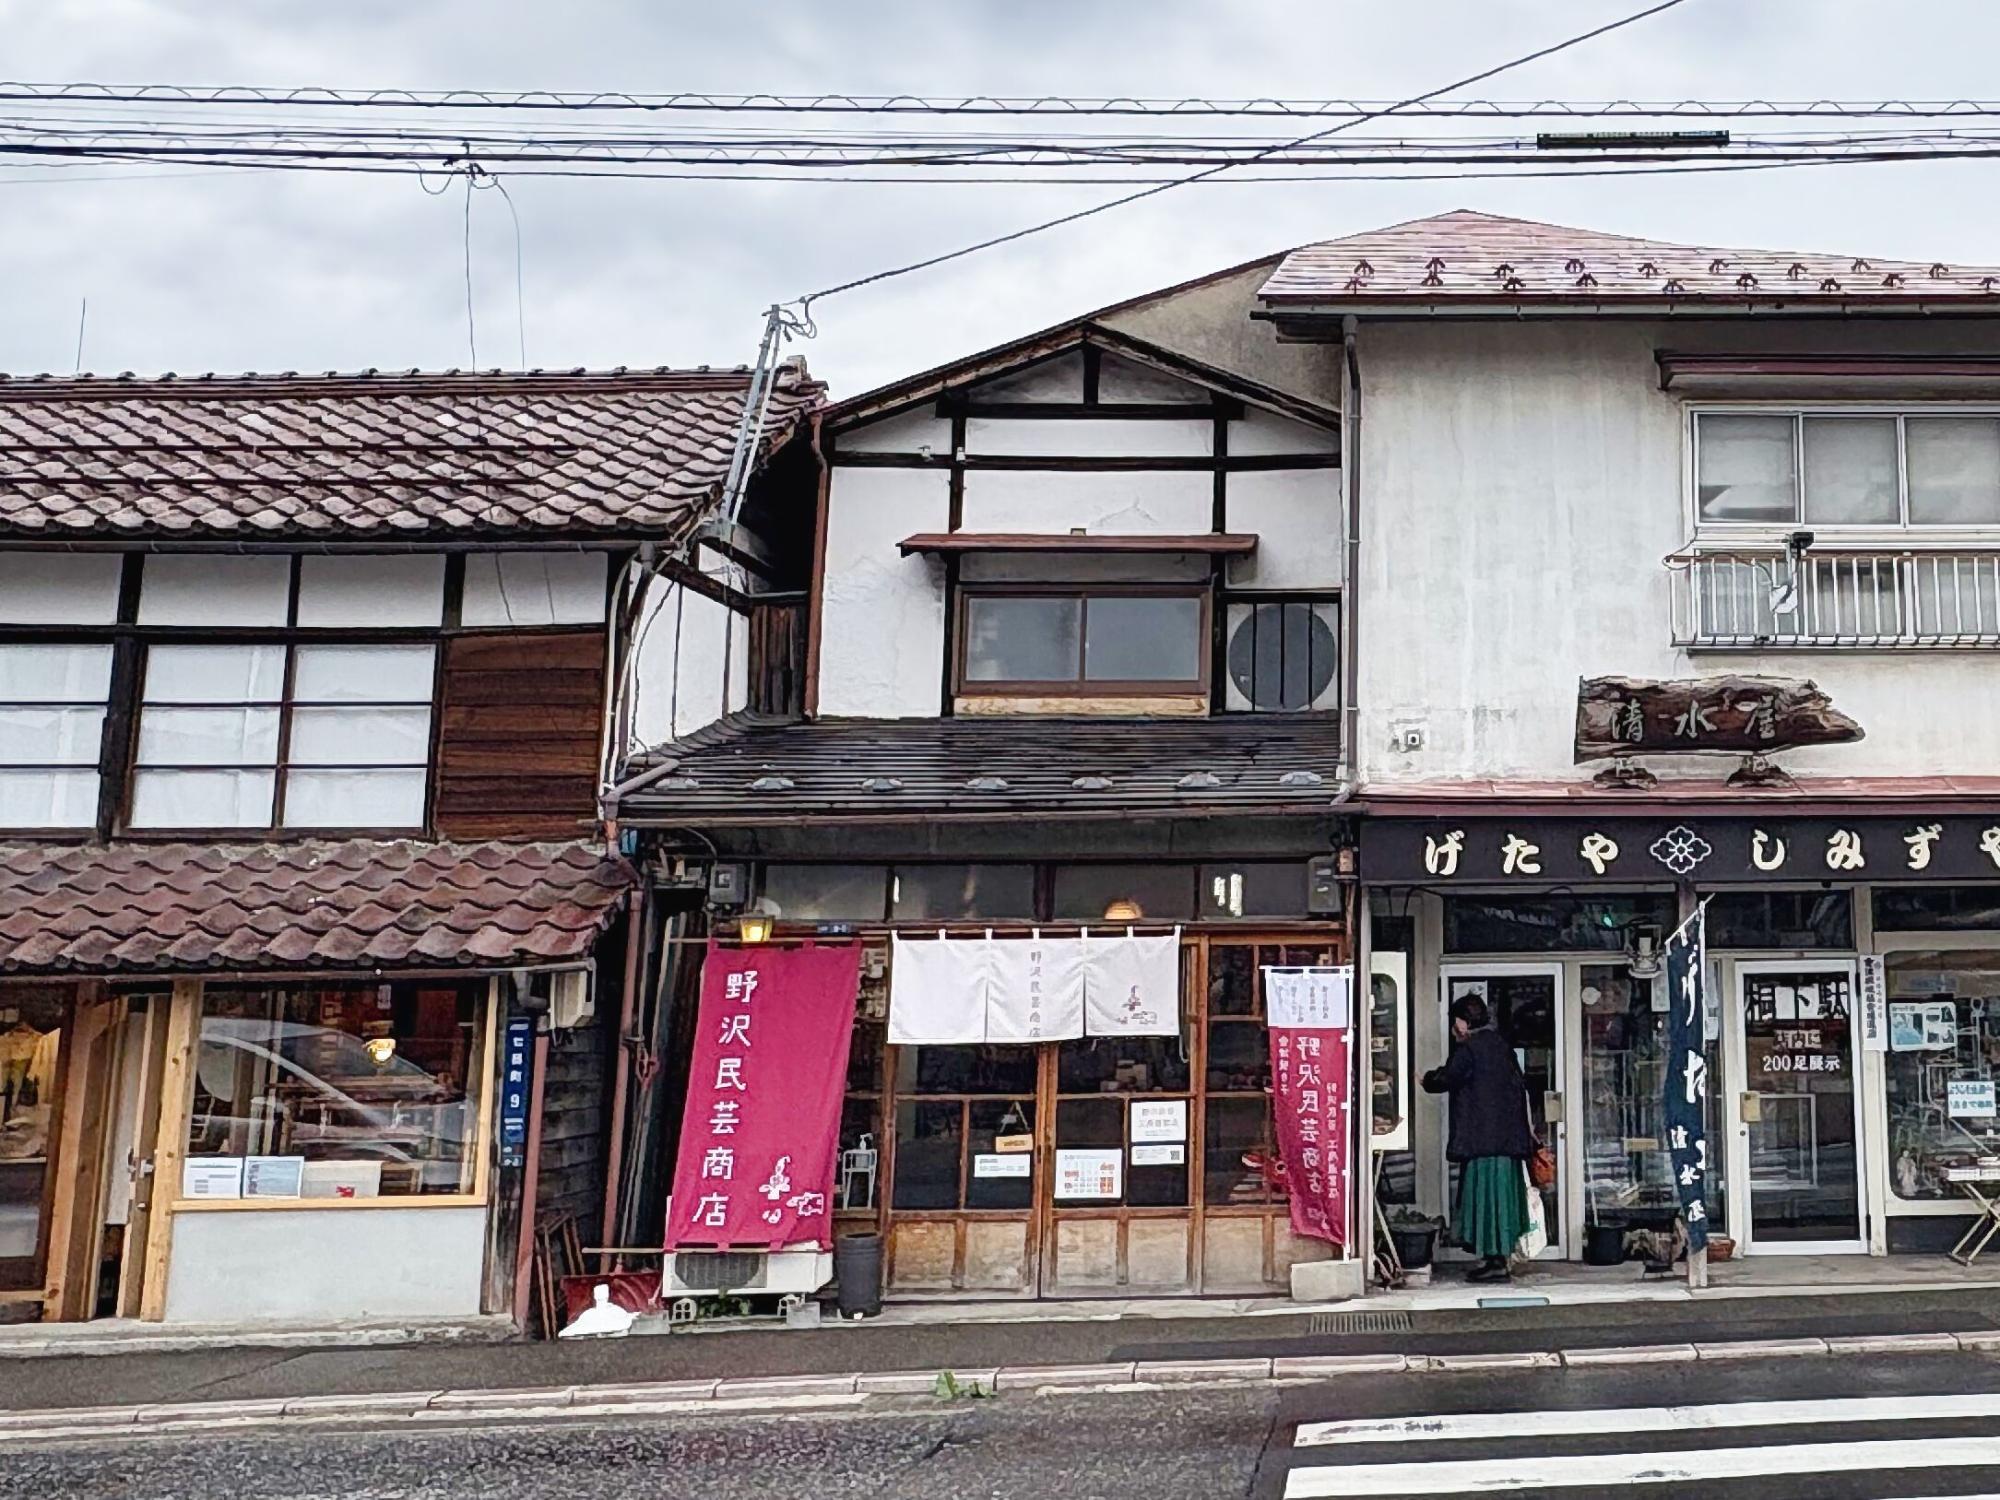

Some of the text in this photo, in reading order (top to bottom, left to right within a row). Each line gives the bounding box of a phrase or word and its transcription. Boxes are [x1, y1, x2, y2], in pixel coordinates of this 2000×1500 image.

[1612, 695, 1775, 742] 清水屋
[1424, 829, 1619, 876] げたや
[1763, 1055, 1841, 1072] 200足展示
[692, 970, 758, 1227] 野沢民芸商店
